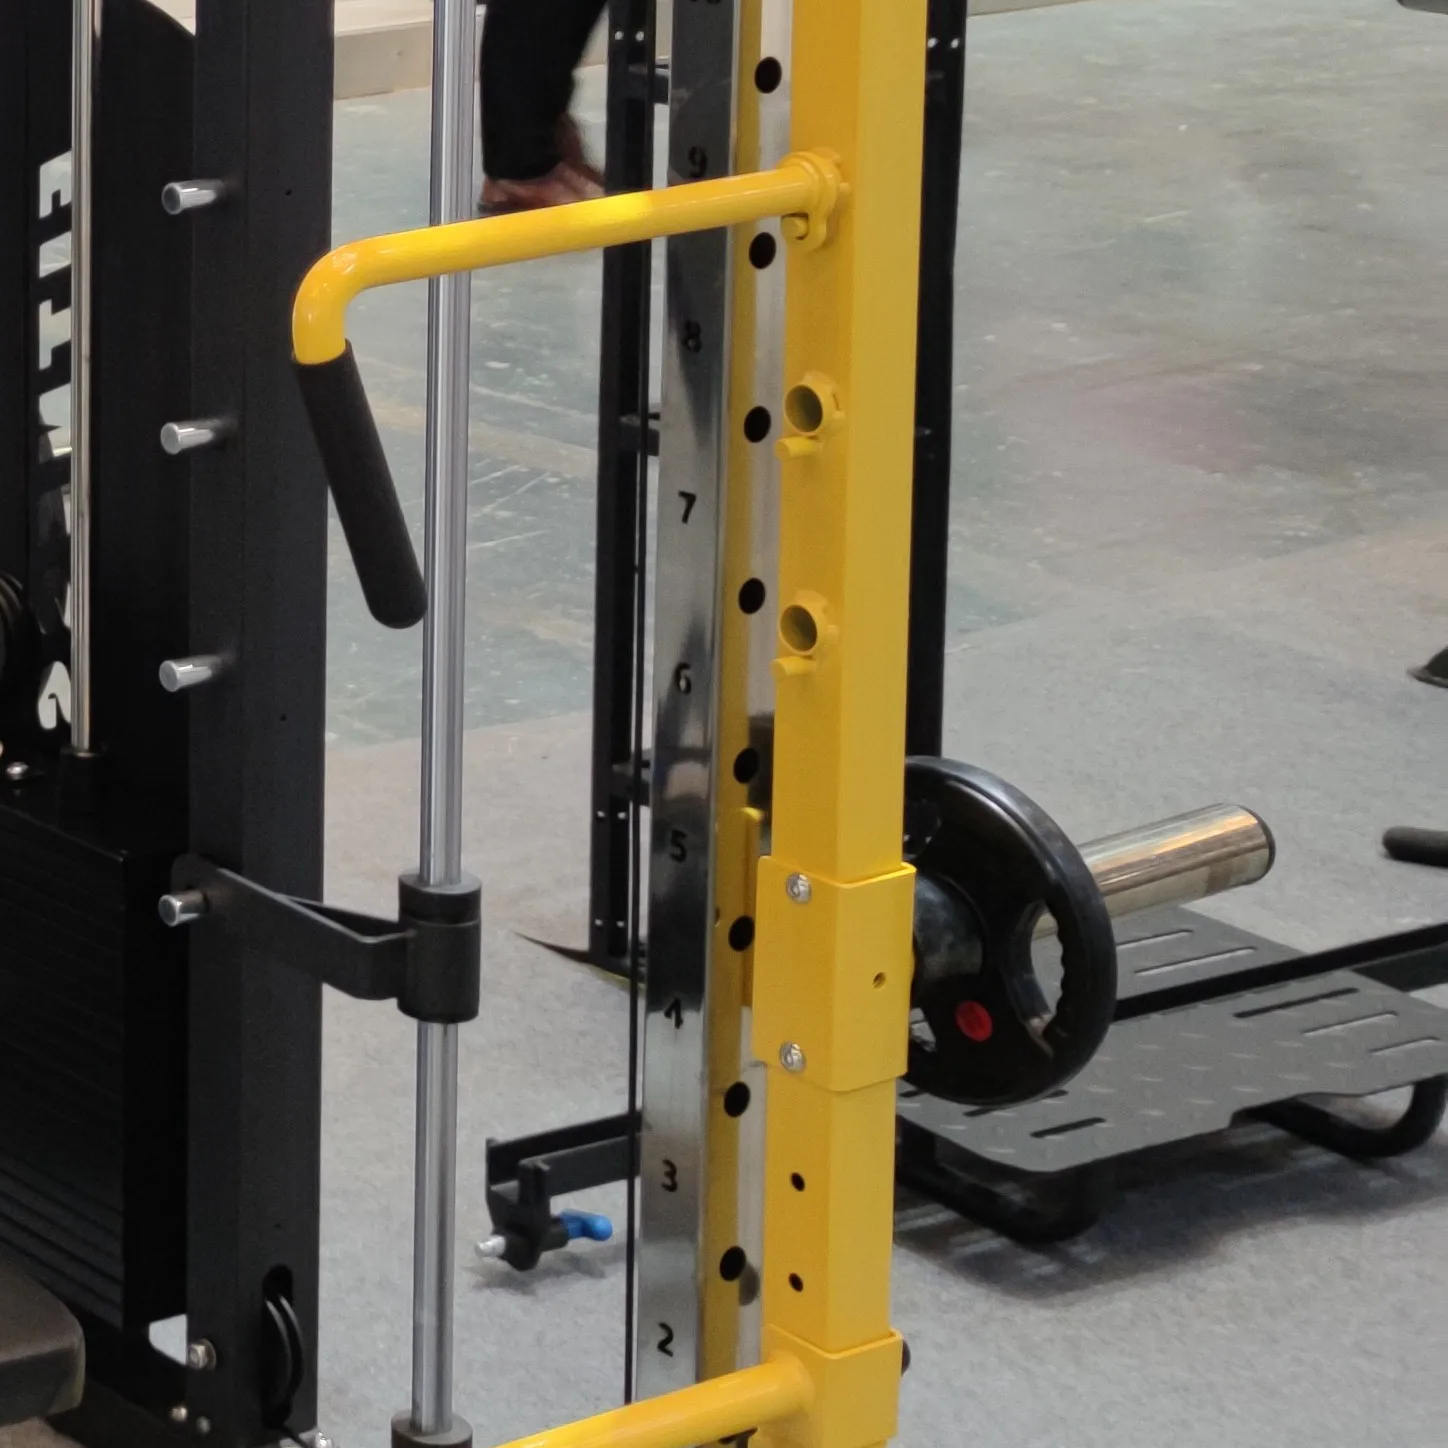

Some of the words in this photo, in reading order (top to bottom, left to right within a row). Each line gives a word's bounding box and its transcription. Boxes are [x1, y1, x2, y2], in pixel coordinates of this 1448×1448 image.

[687, 147, 707, 180] 9
[684, 320, 703, 353] 8
[678, 489, 697, 524] 7
[674, 662, 692, 695] 6
[669, 829, 688, 863] 5
[663, 997, 684, 1030] 4
[660, 1159, 679, 1193] 3
[657, 1322, 674, 1358] 2
